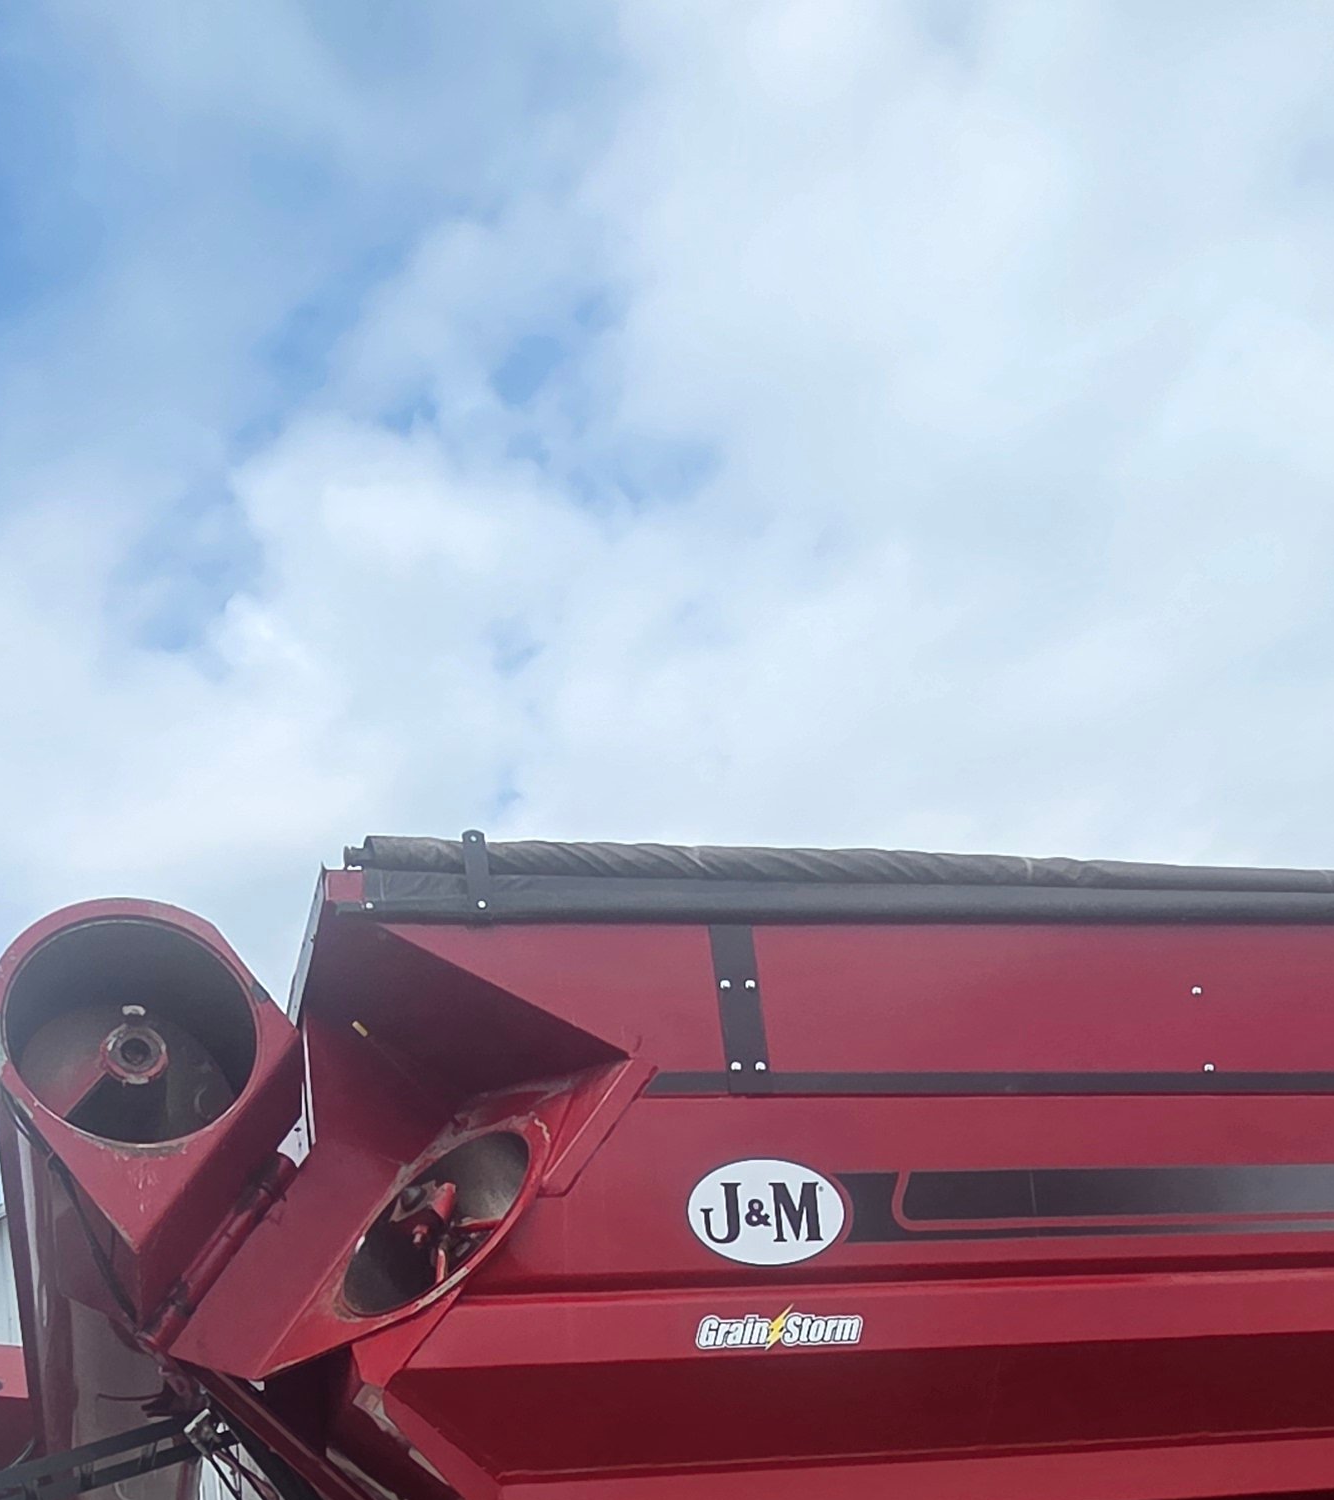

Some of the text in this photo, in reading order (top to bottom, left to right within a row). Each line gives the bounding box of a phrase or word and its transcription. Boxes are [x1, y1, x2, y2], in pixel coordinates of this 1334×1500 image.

[699, 1181, 824, 1244] J&M
[698, 1314, 862, 1347] Grain Storm
